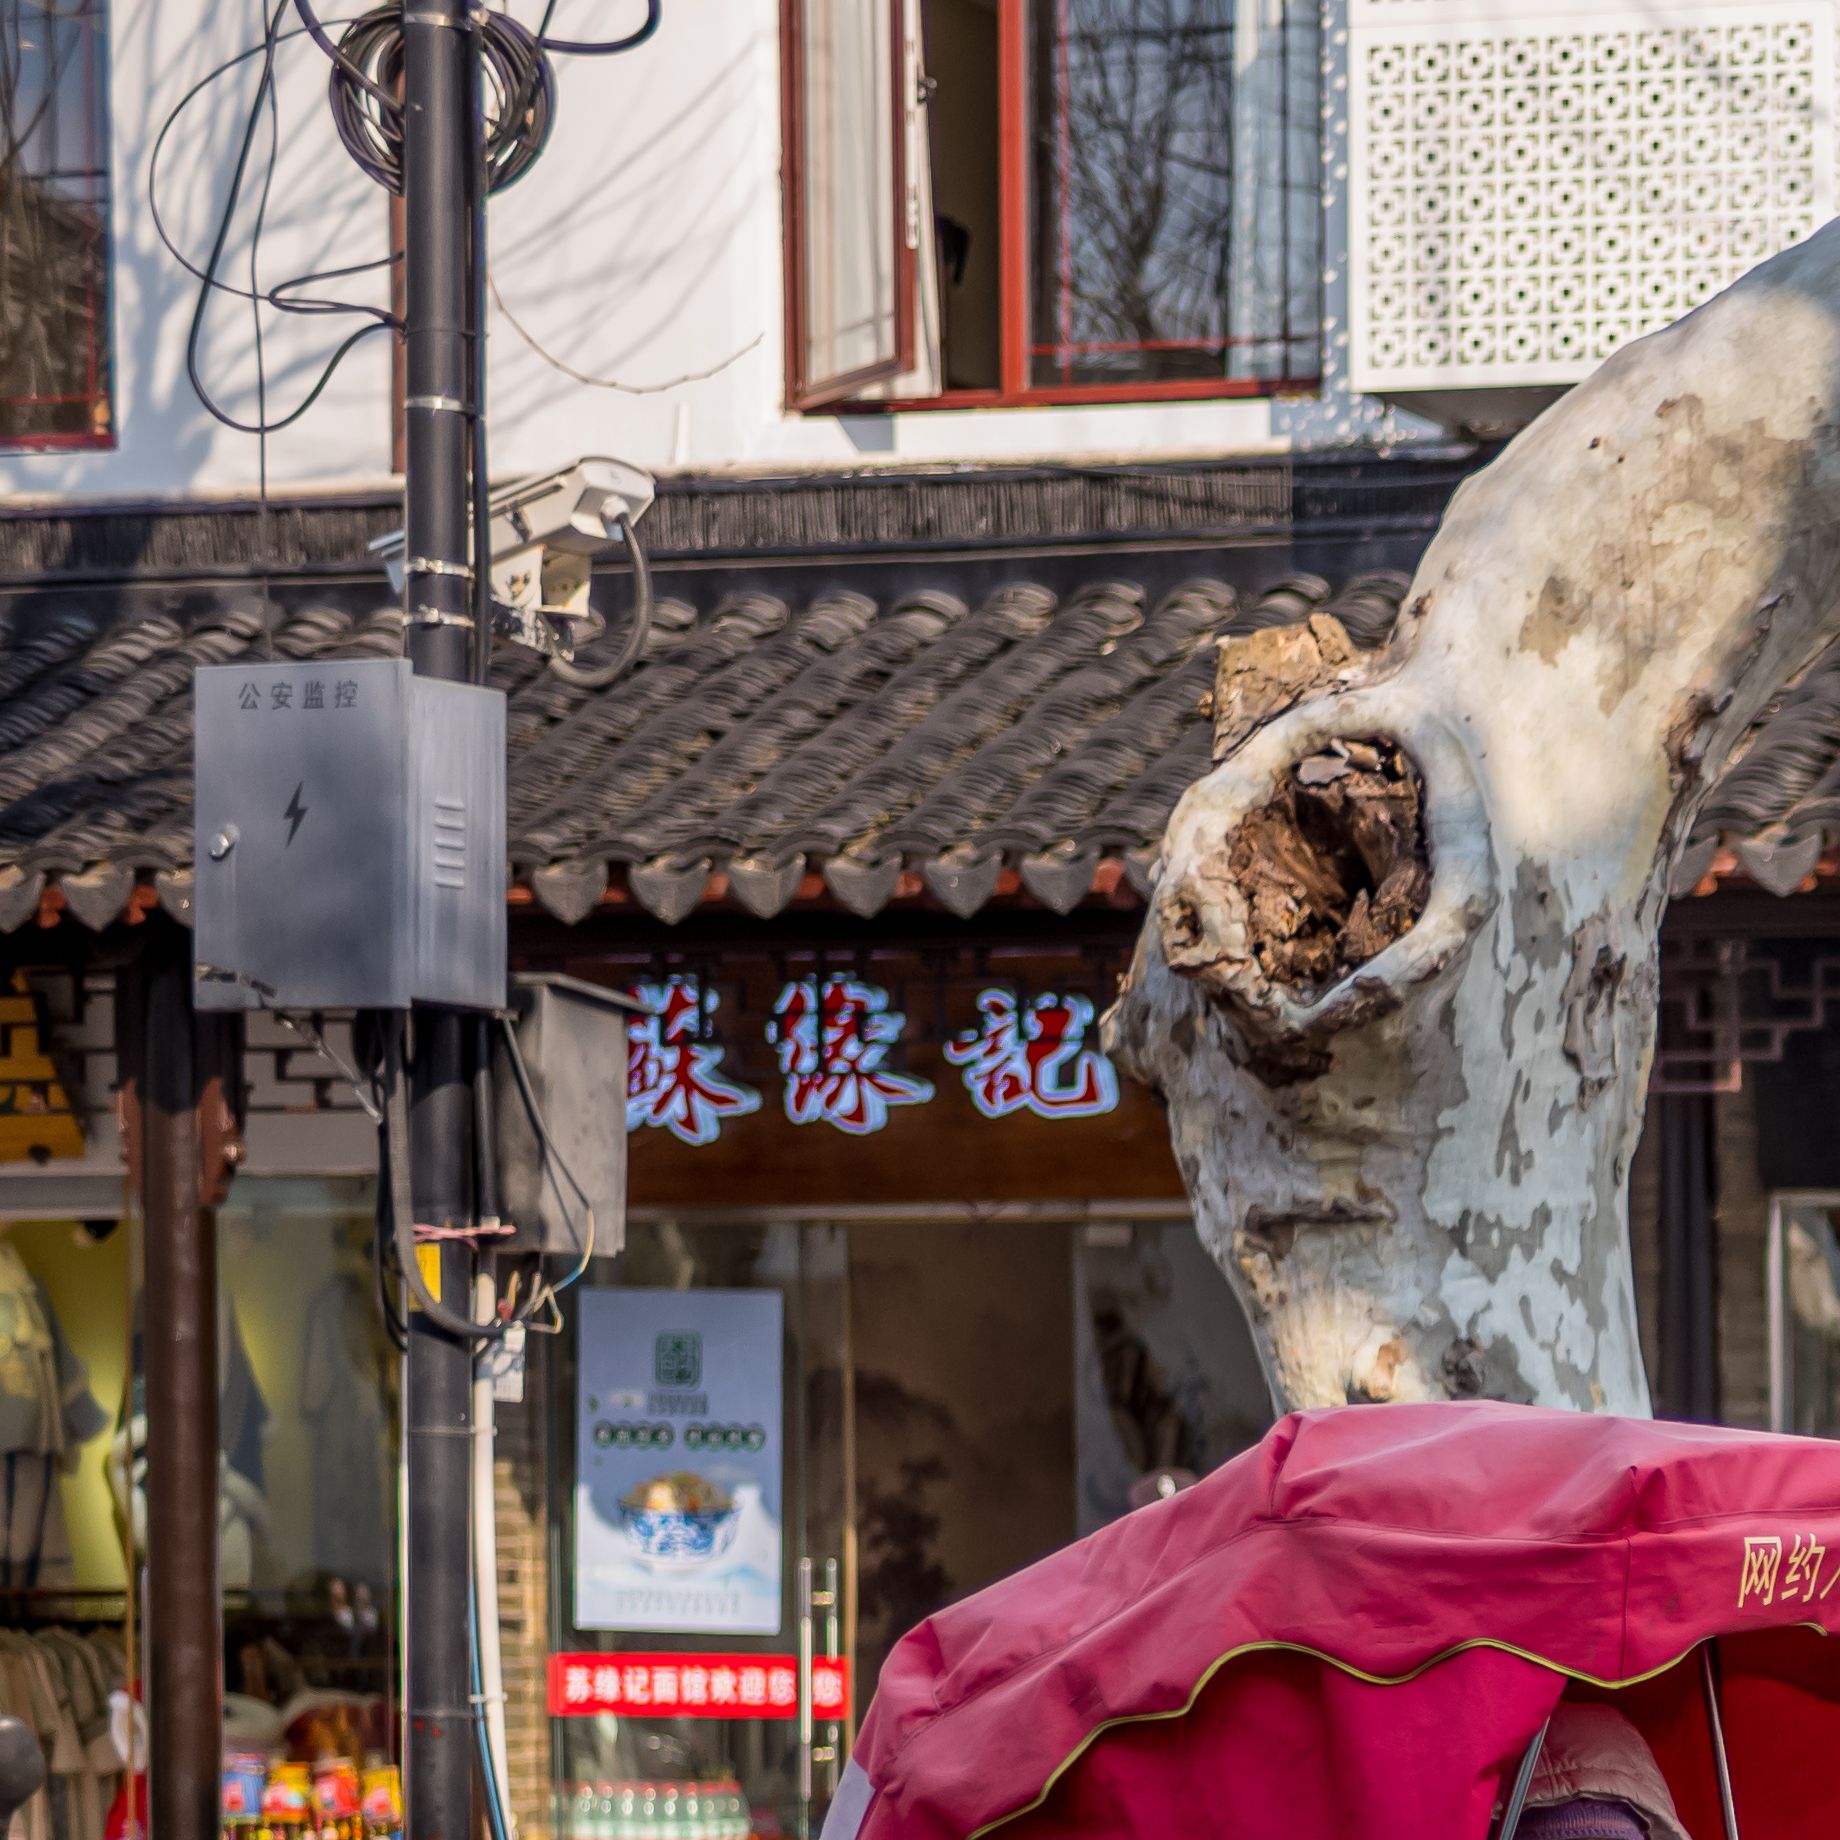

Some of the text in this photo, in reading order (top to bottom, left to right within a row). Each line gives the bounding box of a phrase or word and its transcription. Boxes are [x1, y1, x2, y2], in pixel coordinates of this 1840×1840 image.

[238, 679, 361, 711] 公安监控
[565, 1664, 796, 1707] 苏缘记面馆欢迎您
